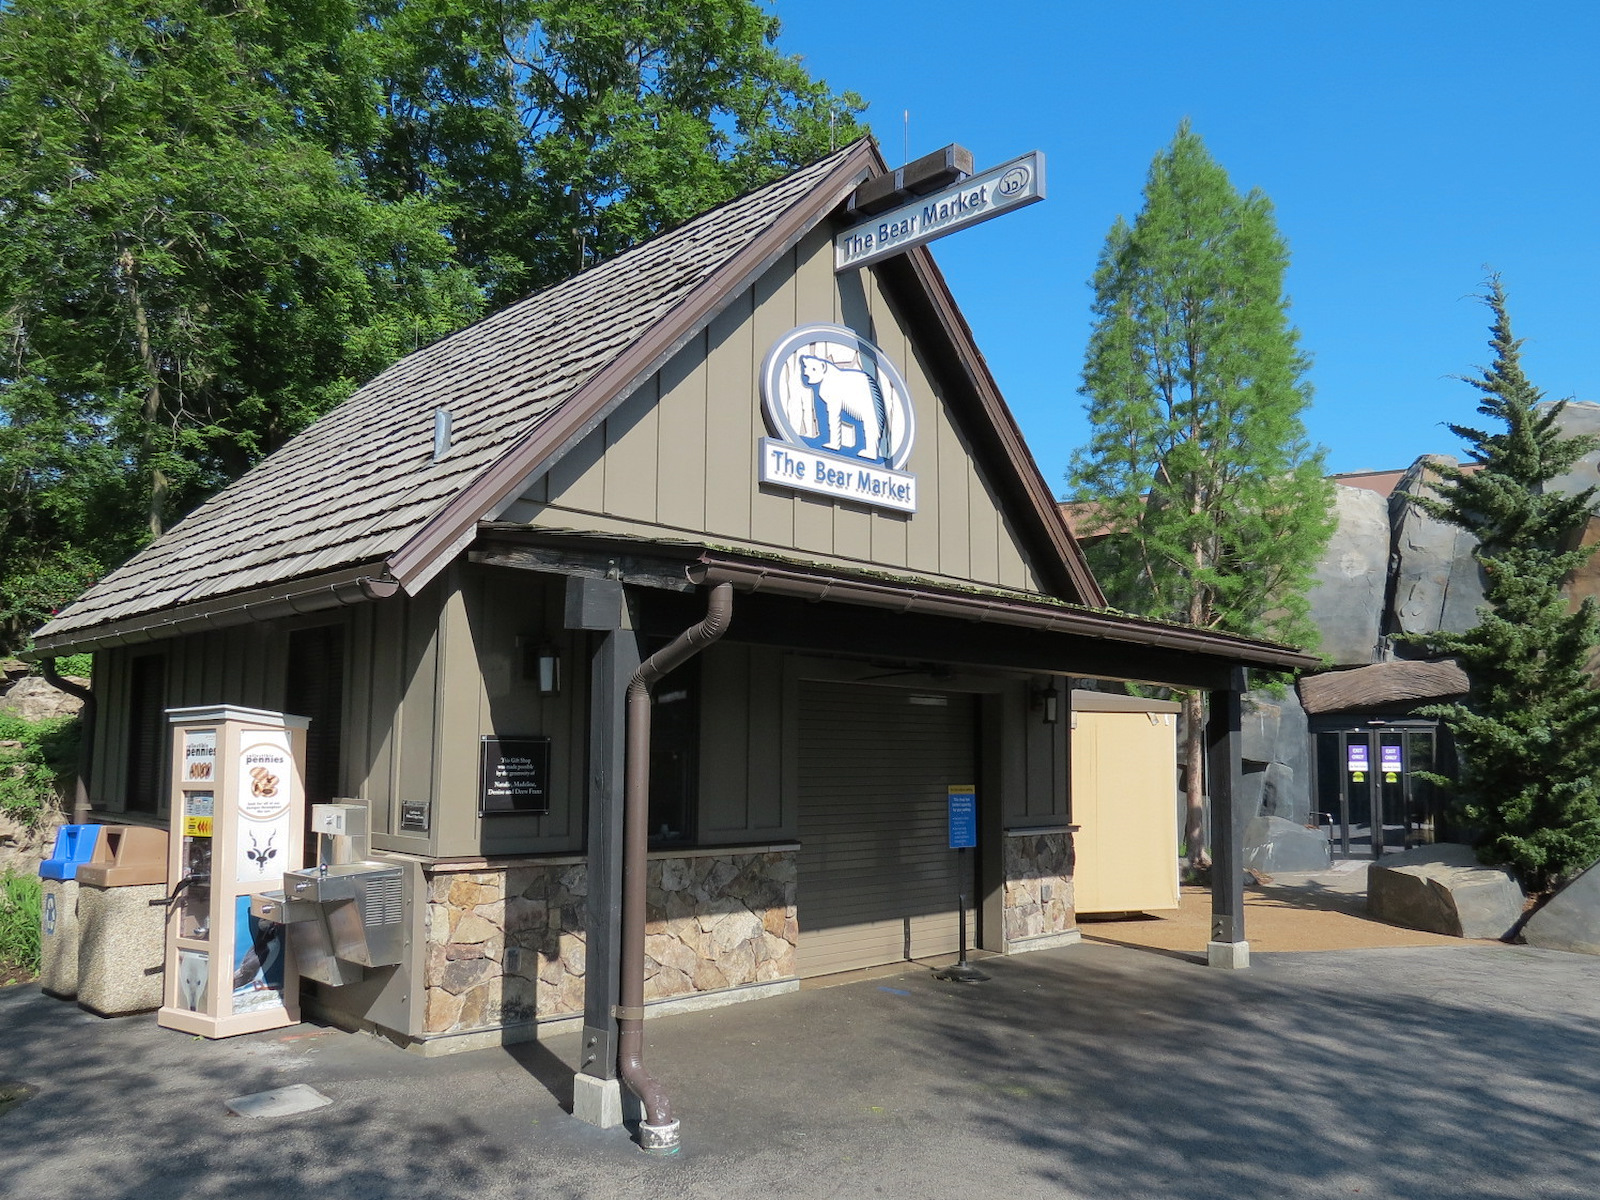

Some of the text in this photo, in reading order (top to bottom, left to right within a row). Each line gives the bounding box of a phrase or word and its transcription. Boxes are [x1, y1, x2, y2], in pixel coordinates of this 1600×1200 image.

[844, 185, 988, 255] The Bear Market
[772, 450, 911, 502] The Bear Market
[186, 748, 216, 759] pennies
[246, 757, 284, 765] pennies
